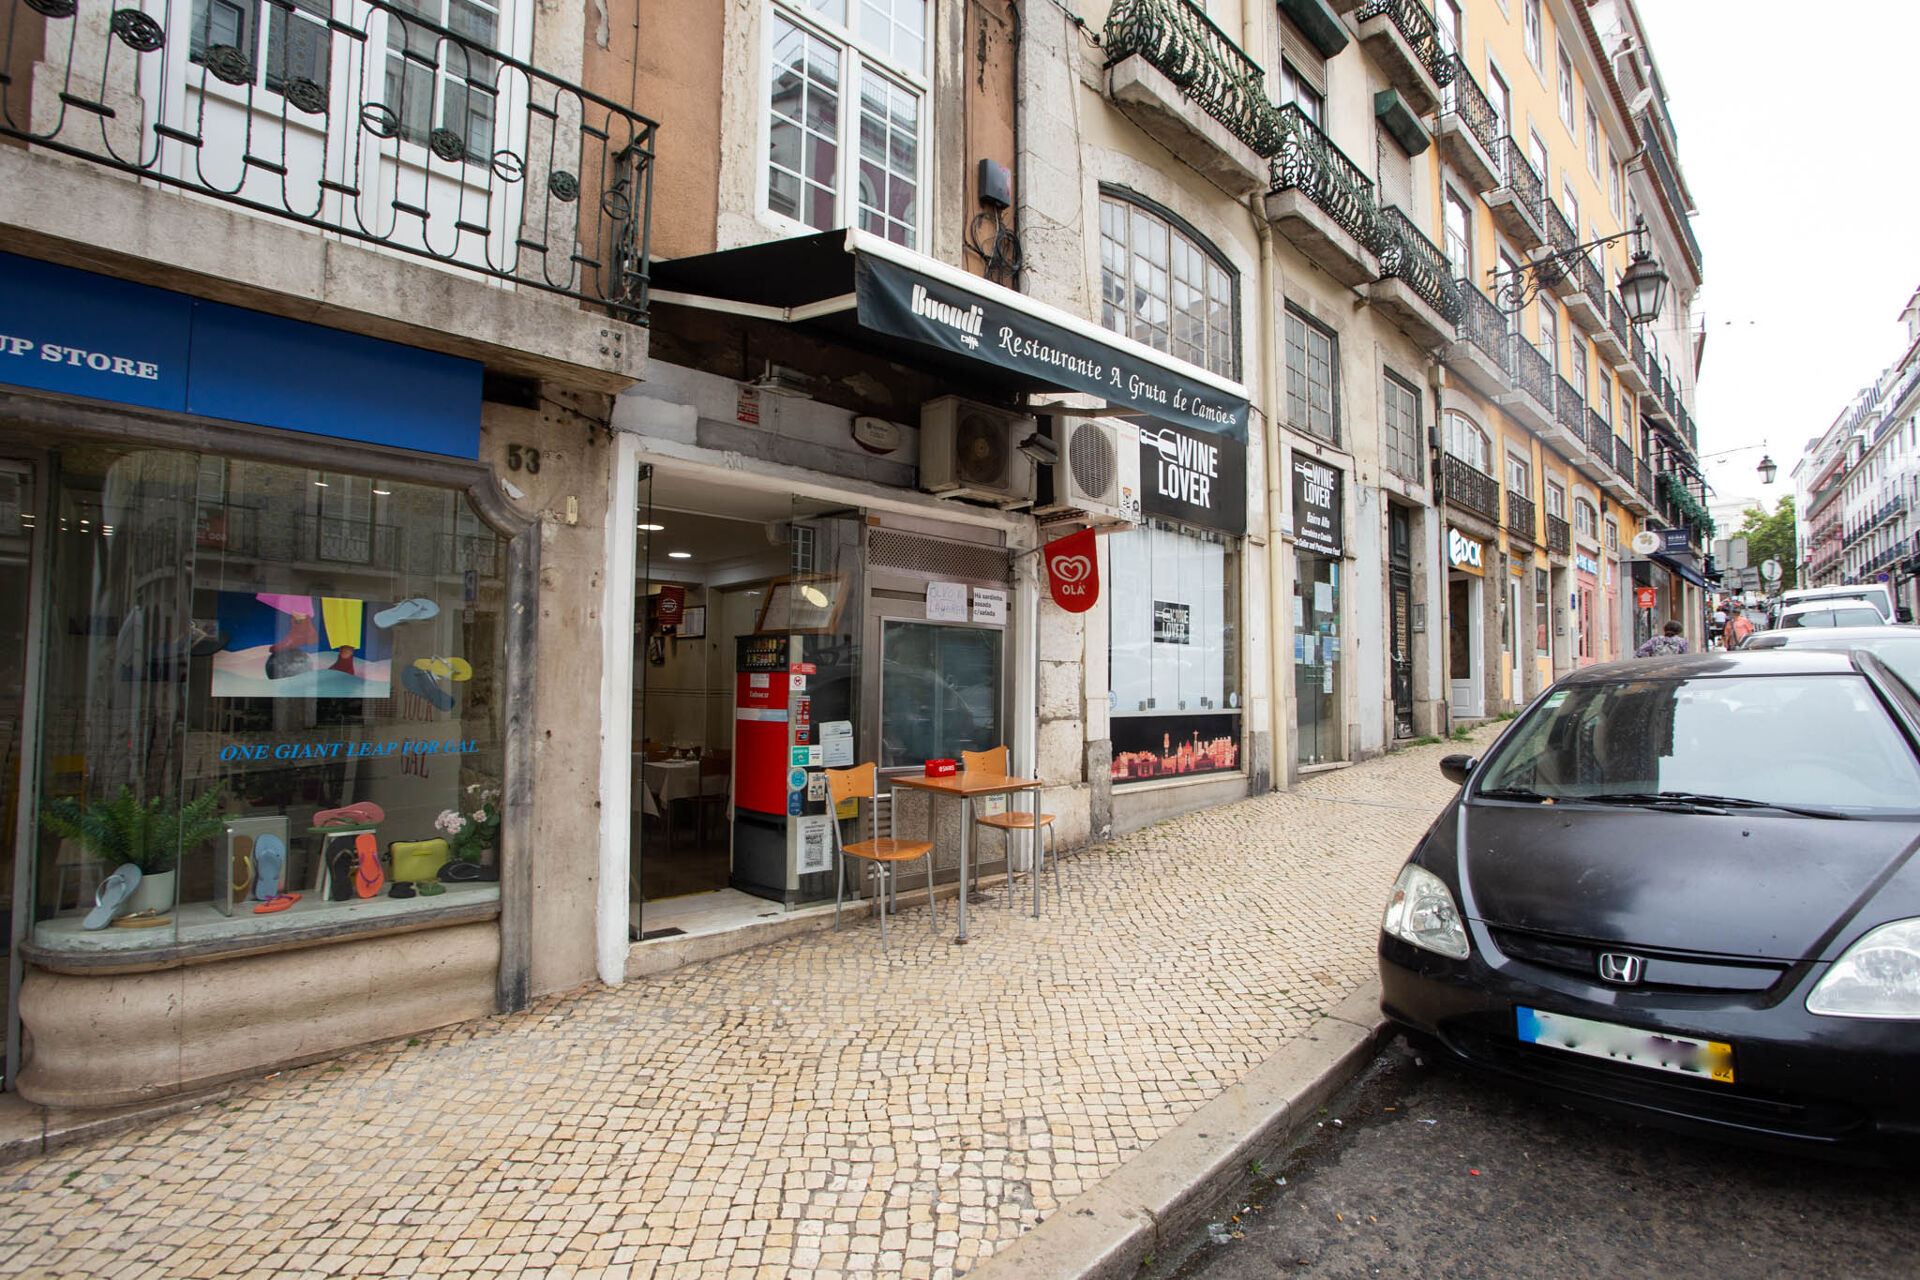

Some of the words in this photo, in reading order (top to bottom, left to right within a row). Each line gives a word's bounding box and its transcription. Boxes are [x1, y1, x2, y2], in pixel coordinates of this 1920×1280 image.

[40, 343, 159, 381] STORE
[998, 326, 1103, 380] Restaurante
[1109, 367, 1123, 389] A
[1128, 374, 1167, 404] Gruta
[1173, 388, 1188, 411] de
[1191, 397, 1237, 425] Camões
[508, 444, 541, 474] 53
[1175, 432, 1219, 478] WINE
[1158, 459, 1211, 509] LOVER
[1311, 463, 1335, 491] WINE
[1303, 480, 1331, 510] LOVER
[1062, 582, 1086, 595] OLÁ
[1162, 622, 1186, 639] LOVER
[220, 743, 269, 761] ONE
[274, 743, 343, 760] GIANT
[347, 741, 399, 758] LEAP
[401, 740, 440, 755] FOR
[443, 739, 480, 753] GAL
